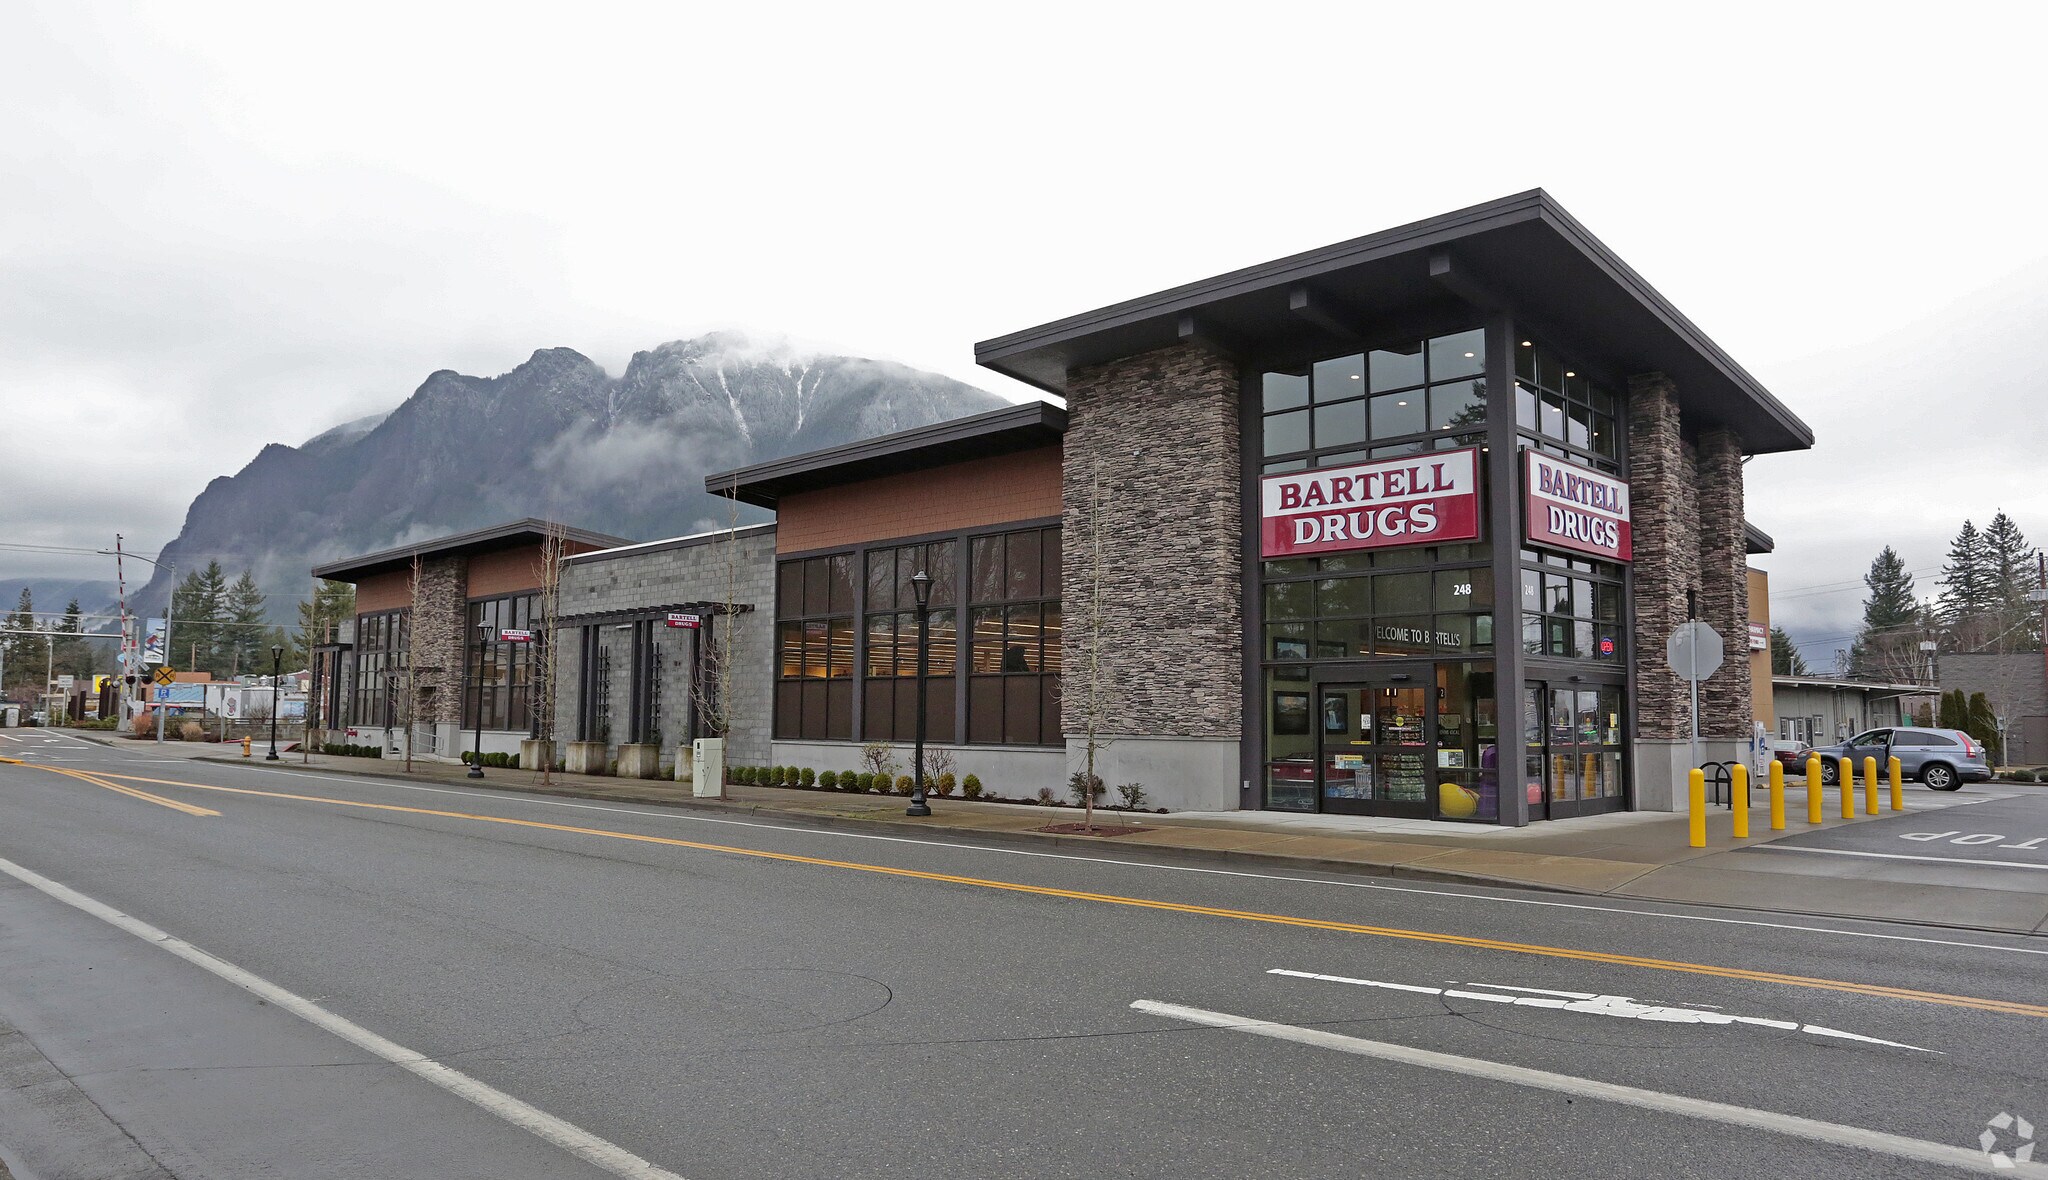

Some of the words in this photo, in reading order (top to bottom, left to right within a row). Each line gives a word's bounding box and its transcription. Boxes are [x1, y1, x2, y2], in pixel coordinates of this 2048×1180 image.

[1279, 463, 1454, 510] BARTELL
[1538, 463, 1624, 514] BARTELL
[1293, 502, 1438, 545] DRUGS
[1547, 505, 1618, 549] DRUGS
[1453, 583, 1472, 596] 248
[1524, 584, 1534, 596] 248
[1375, 626, 1409, 641] ELCOME
[1411, 629, 1422, 643] TO
[1424, 630, 1460, 646] BRTELL'S
[1600, 641, 1614, 652] OPEN
[1899, 831, 2048, 850] TOP
